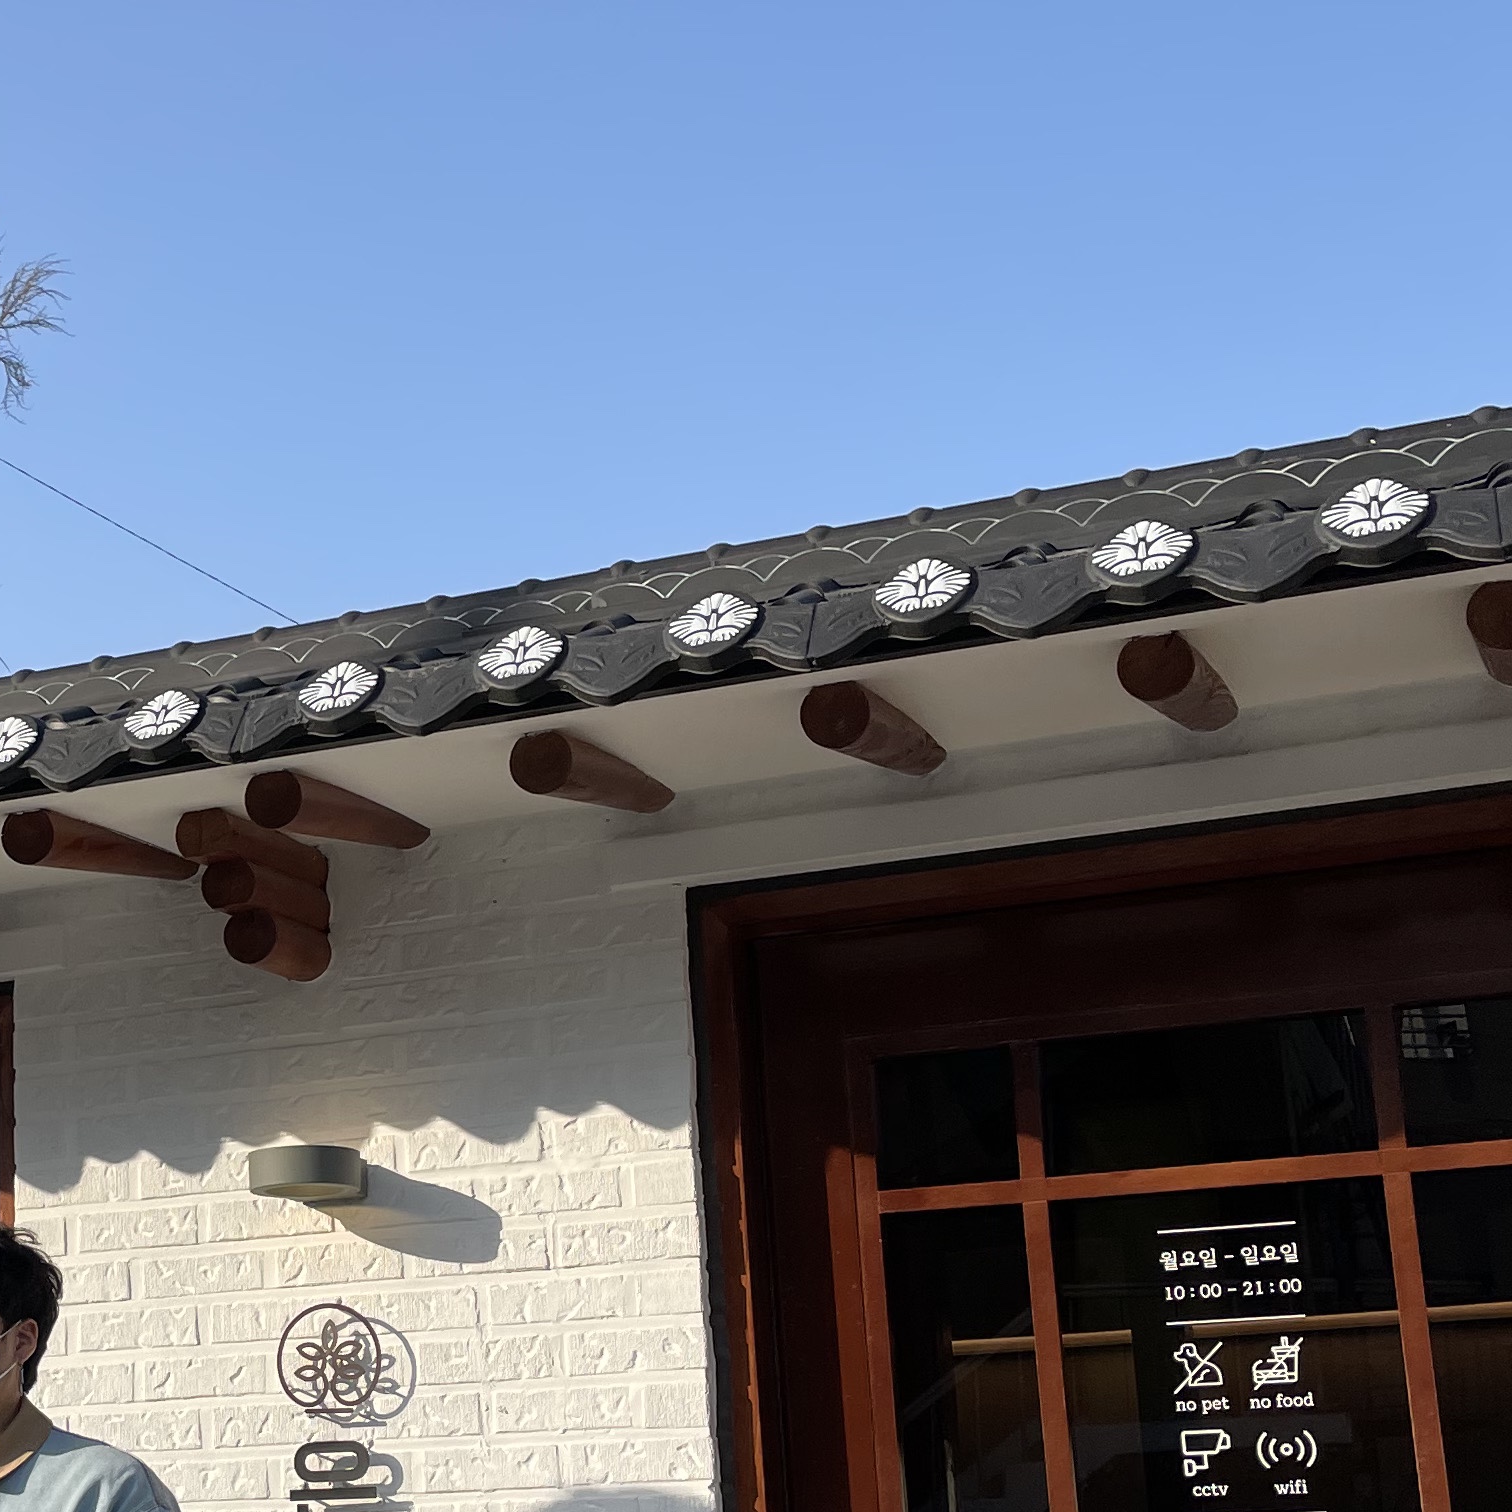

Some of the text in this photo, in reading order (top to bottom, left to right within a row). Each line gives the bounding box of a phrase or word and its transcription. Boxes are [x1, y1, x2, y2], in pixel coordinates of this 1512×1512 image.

[1159, 1248, 1218, 1271] 월요일
[1240, 1241, 1299, 1266] 일요일
[1175, 1396, 1230, 1415] no pet
[1249, 1392, 1315, 1409] no food
[1192, 1483, 1229, 1496] cctv
[1273, 1479, 1308, 1495] wifi
